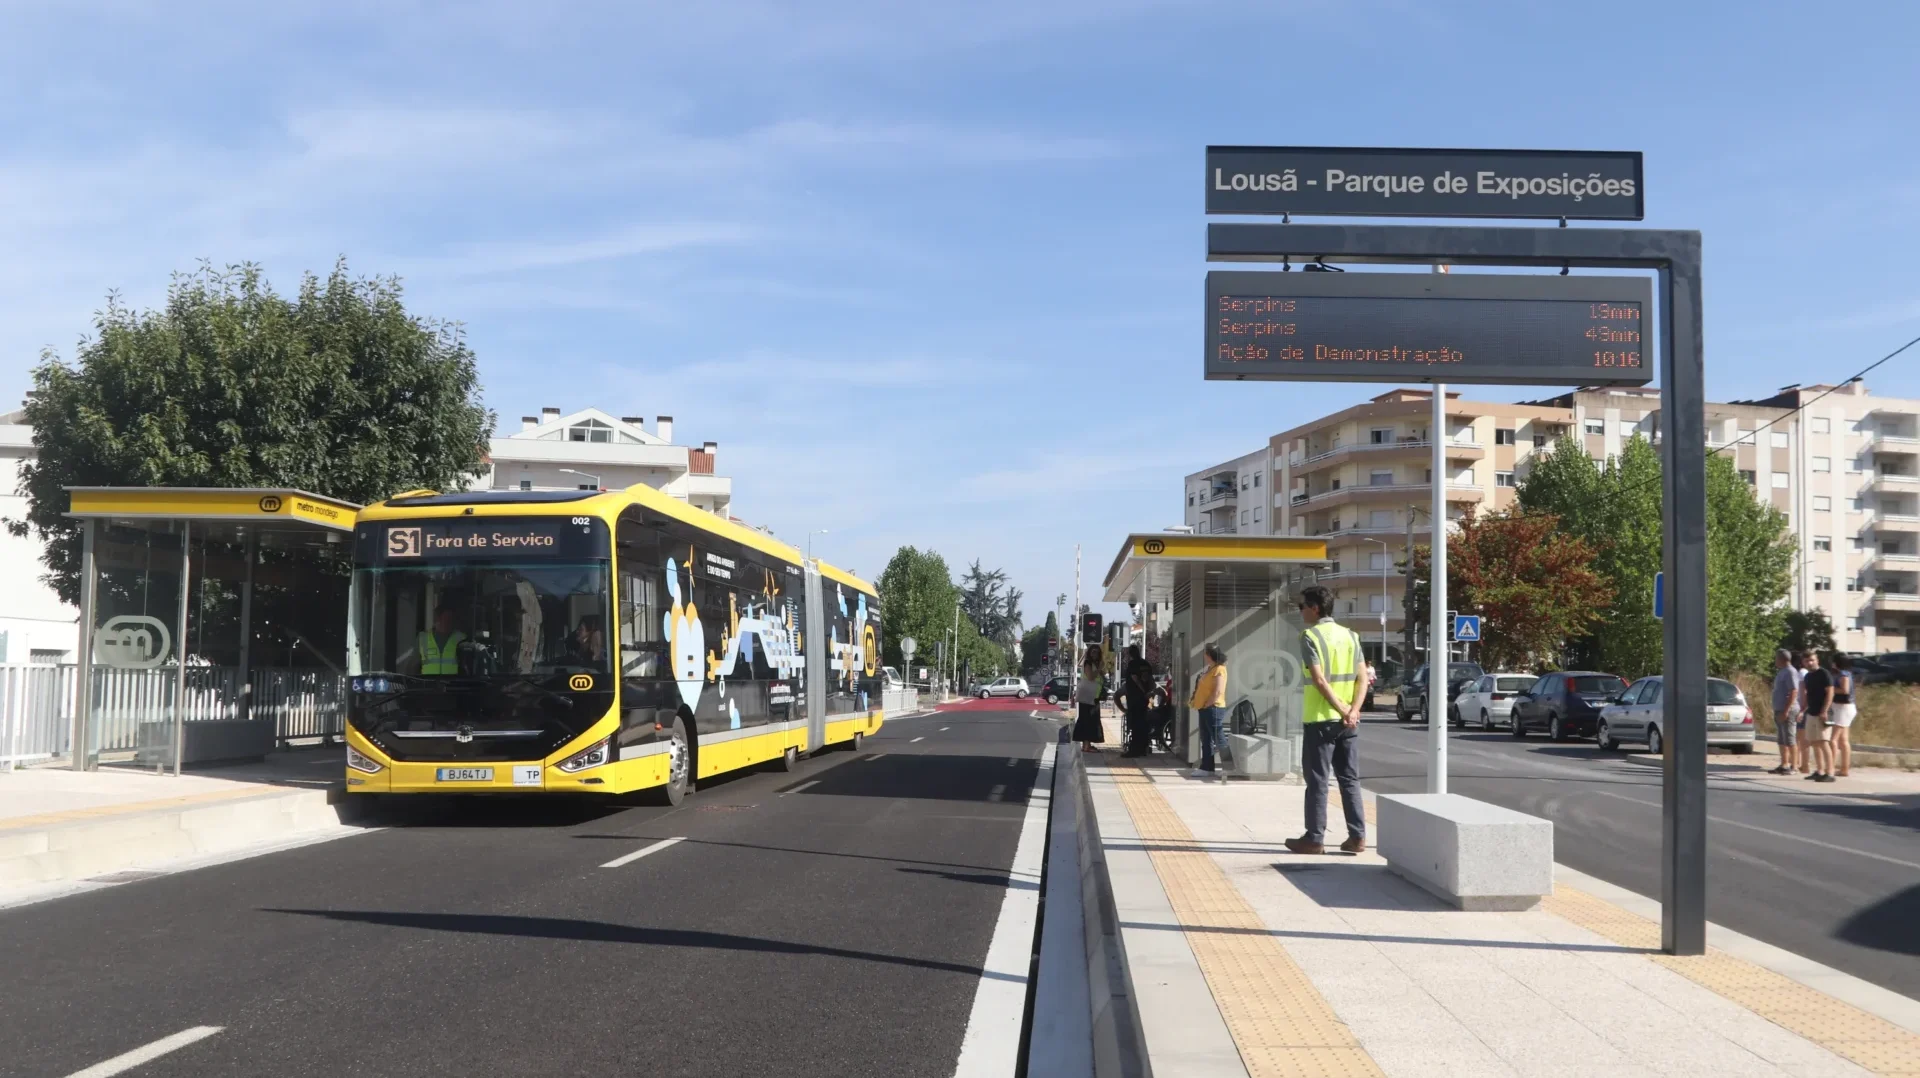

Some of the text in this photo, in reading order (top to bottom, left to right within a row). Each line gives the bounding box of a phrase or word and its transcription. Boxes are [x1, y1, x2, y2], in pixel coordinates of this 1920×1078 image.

[1215, 168, 1298, 192] Lousã
[1326, 169, 1425, 198] Parque
[1433, 171, 1468, 194] de
[1477, 171, 1636, 202] Exposições
[1219, 296, 1296, 316] Serpins
[1589, 303, 1640, 319] 19min
[1219, 318, 1296, 338] Serpins
[1584, 326, 1640, 342] 49min
[1218, 343, 1463, 366] Ação de Demonstração
[296, 502, 339, 520] metro mondego
[572, 517, 591, 526] 002
[390, 530, 420, 554] S1
[426, 533, 463, 548] Fora
[468, 532, 488, 547] de
[448, 769, 488, 780] BJ64TJ
[526, 770, 540, 780] TP
